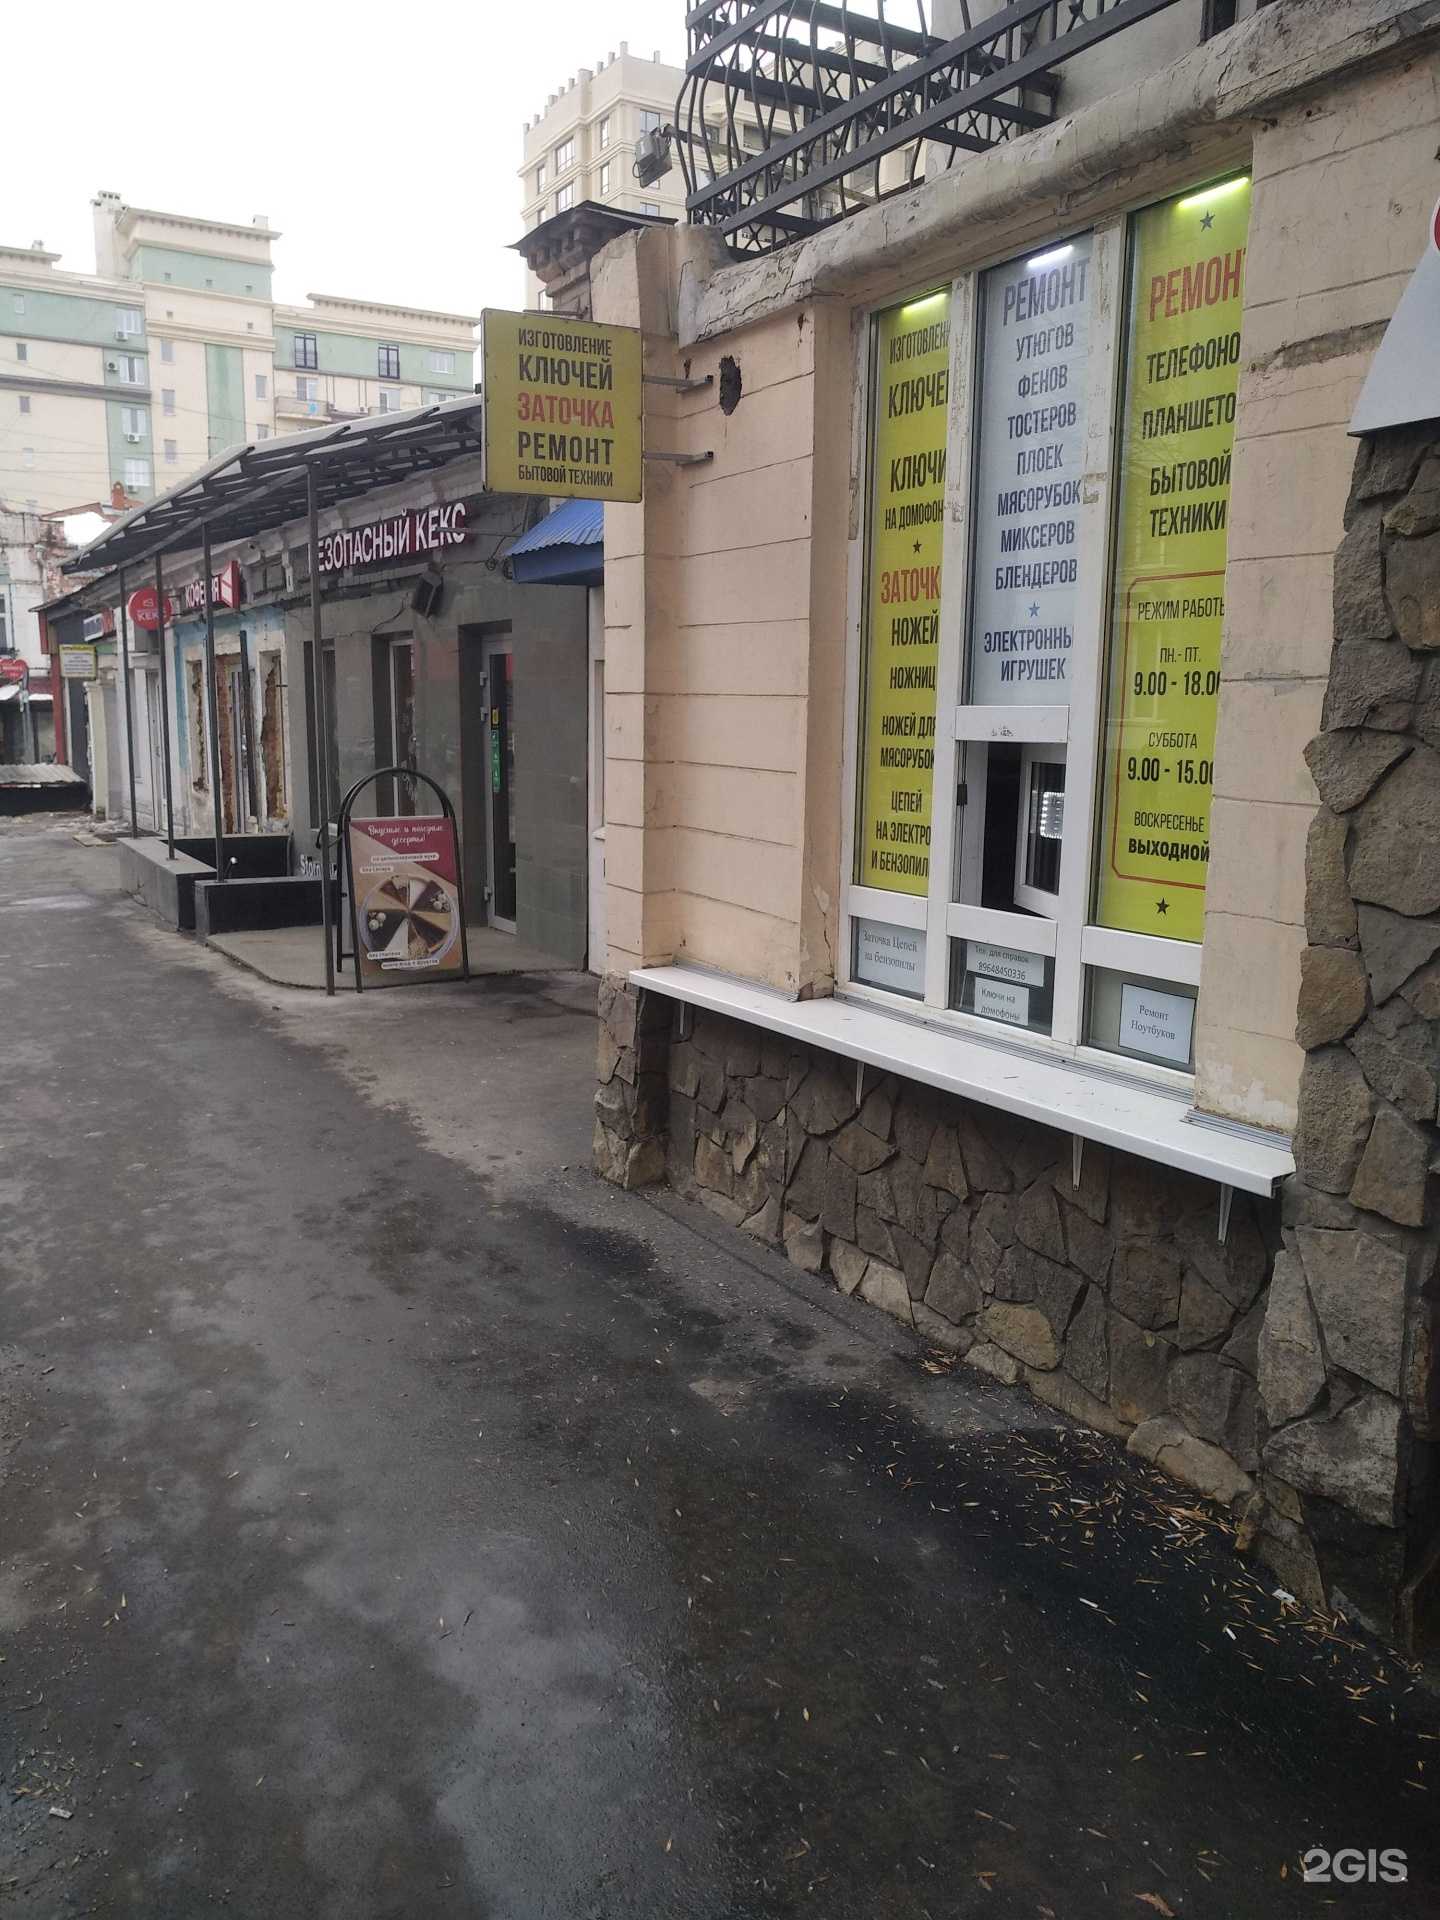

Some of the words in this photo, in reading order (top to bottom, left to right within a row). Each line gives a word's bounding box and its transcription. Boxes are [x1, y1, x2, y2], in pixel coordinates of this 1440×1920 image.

[1003, 257, 1090, 326] РЕМОНТ
[1149, 247, 1247, 322] РЕМОН
[518, 328, 612, 357] ИЗГОТОВЛЕНИЕ
[1016, 322, 1074, 362] УТЮГОВ
[1146, 331, 1241, 384] ТЕЛЕФОНО
[519, 354, 613, 391] КЛЮЧЕЙ
[1018, 363, 1068, 399] ФЕНОВ
[517, 392, 614, 429] ЗАТОЧКА
[1008, 401, 1077, 440] ТОСТЕРОВ
[1142, 391, 1236, 440] ПЛАНШЕТО
[518, 431, 614, 465] РЕМОНТ
[1016, 443, 1064, 476] ПЛОЕК
[518, 465, 566, 483] БЫТОВОЙ
[568, 468, 613, 487] ТЕХНИКИ
[890, 448, 947, 492] КЛЮЧИ
[1150, 448, 1231, 496] БЫТОВОЙ
[997, 479, 1082, 517] МЯСОРУБОК
[885, 507, 897, 530] НА
[1150, 499, 1227, 537] ТЕХНИКИ
[308, 508, 410, 574] ЕЗОПАСНЫЙ
[415, 502, 466, 551] КЕКС
[1001, 519, 1075, 553] МИКСЕРОВ
[880, 566, 942, 604] ЗАТОЧК
[995, 558, 1078, 590] БЛЕНДЕРОВ
[1137, 600, 1179, 620] РЕЖИМ
[891, 608, 939, 646] НОЖЕЙ
[889, 665, 936, 691] НОЖНИЦ
[1000, 657, 1066, 681] ИГРУШЕК
[1134, 671, 1167, 696] 9.00
[882, 712, 916, 737] НОЖЕЙ
[1149, 732, 1198, 749] СУББОТА
[1128, 757, 1160, 782] 9.00
[891, 789, 922, 814] ЦЕПЕЙ
[875, 820, 888, 840] НА
[890, 821, 931, 846] ЭЛЕКТРО
[1134, 811, 1205, 833] ВОСКРЕСЕНЬЕ
[871, 850, 878, 869] И
[1128, 838, 1210, 863] ВЫХОДНОЙ
[1139, 1005, 1168, 1021] Ремонт
